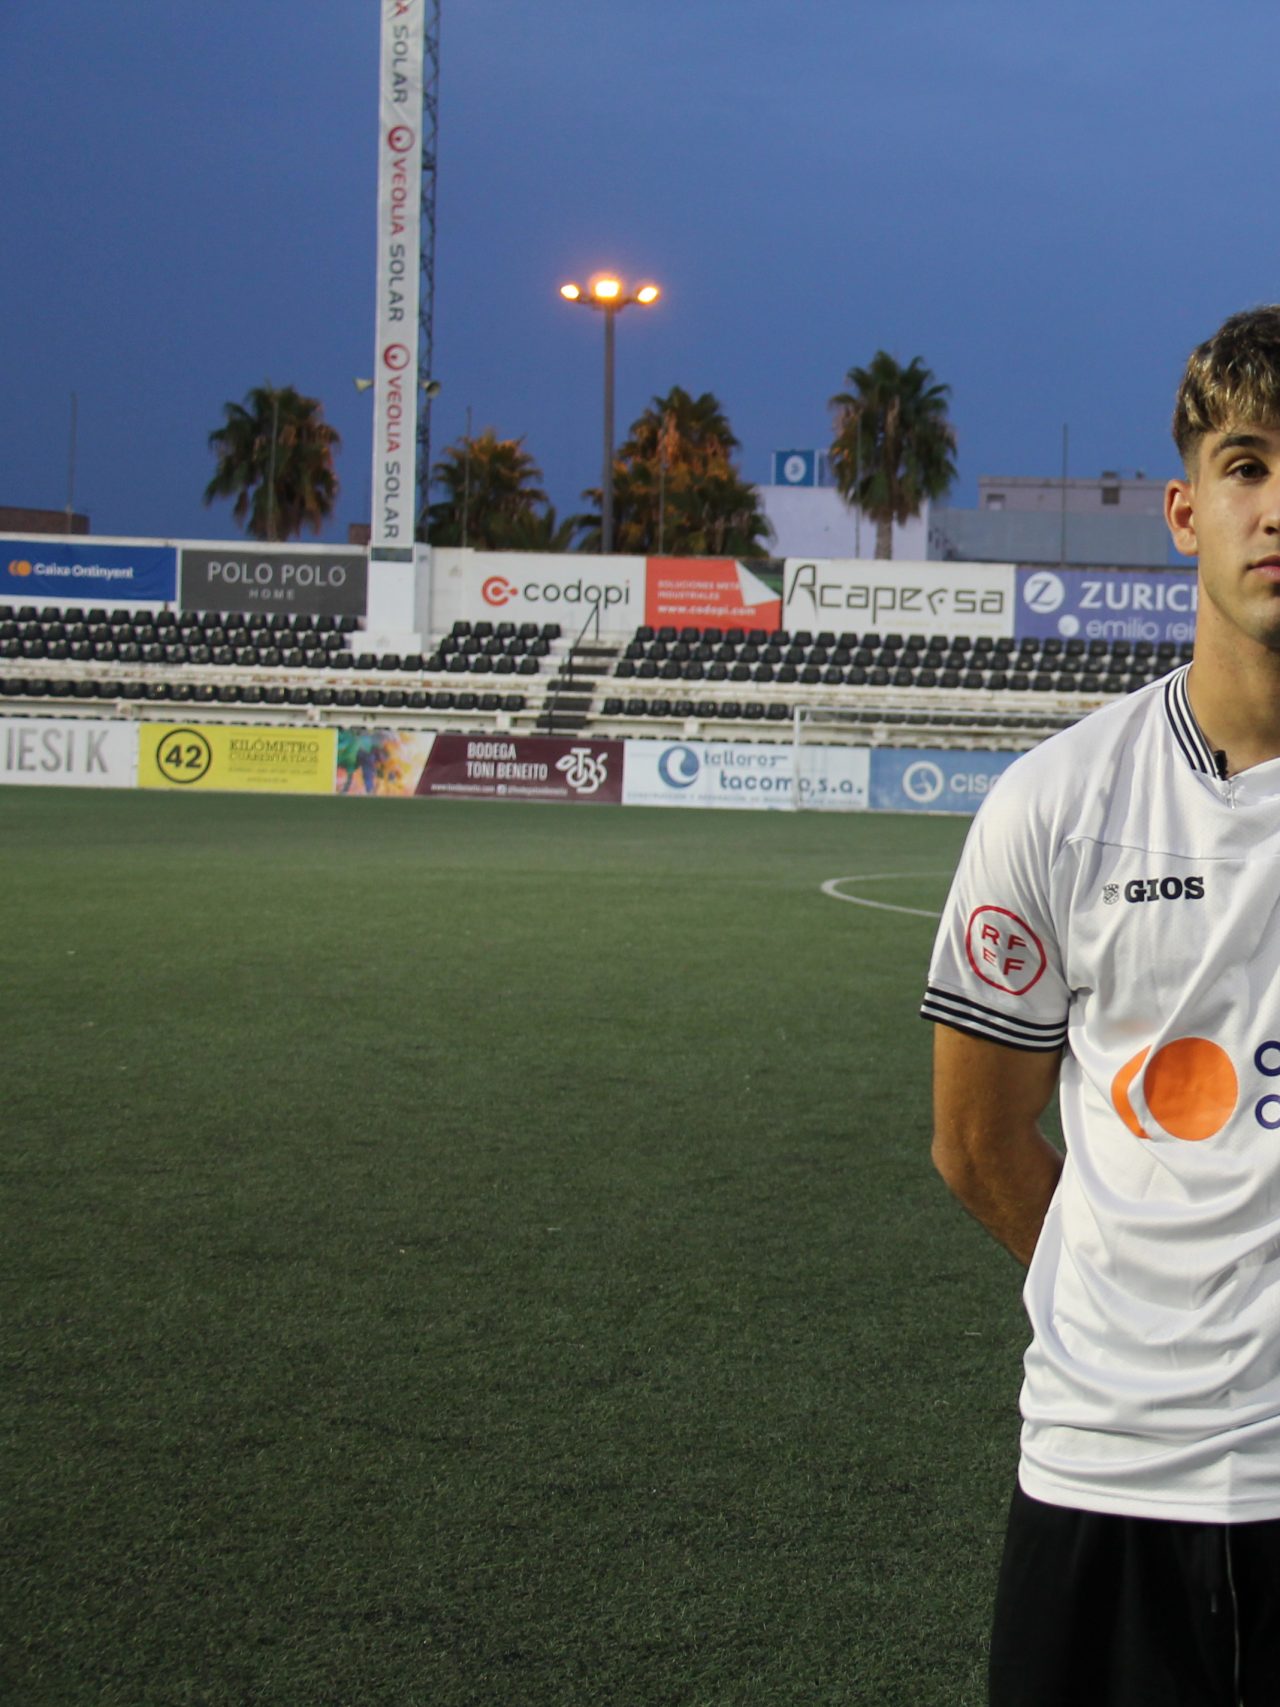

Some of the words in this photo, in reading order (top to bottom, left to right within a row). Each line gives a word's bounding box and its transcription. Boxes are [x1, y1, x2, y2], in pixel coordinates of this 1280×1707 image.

[393, 25, 409, 103] SOLAR
[390, 158, 407, 236] VEOLIA
[388, 243, 405, 322] SOLAR
[386, 376, 402, 454] VEOLIA
[384, 461, 401, 539] SOLAR
[33, 562, 71, 577] Caixa
[72, 564, 134, 581] Ontinyent
[207, 561, 274, 584] POLO
[281, 564, 347, 588] POLO
[248, 588, 297, 600] HOME
[524, 578, 630, 610] codopi
[1079, 581, 1197, 612] ZURIC
[1085, 616, 1159, 640] emilio
[165, 744, 203, 769] 42
[228, 738, 320, 753] KILÓMETRO
[466, 741, 518, 760] BODEGA
[466, 761, 495, 777] TONI
[498, 762, 549, 781] BENEITO
[1124, 876, 1205, 903] GIOS
